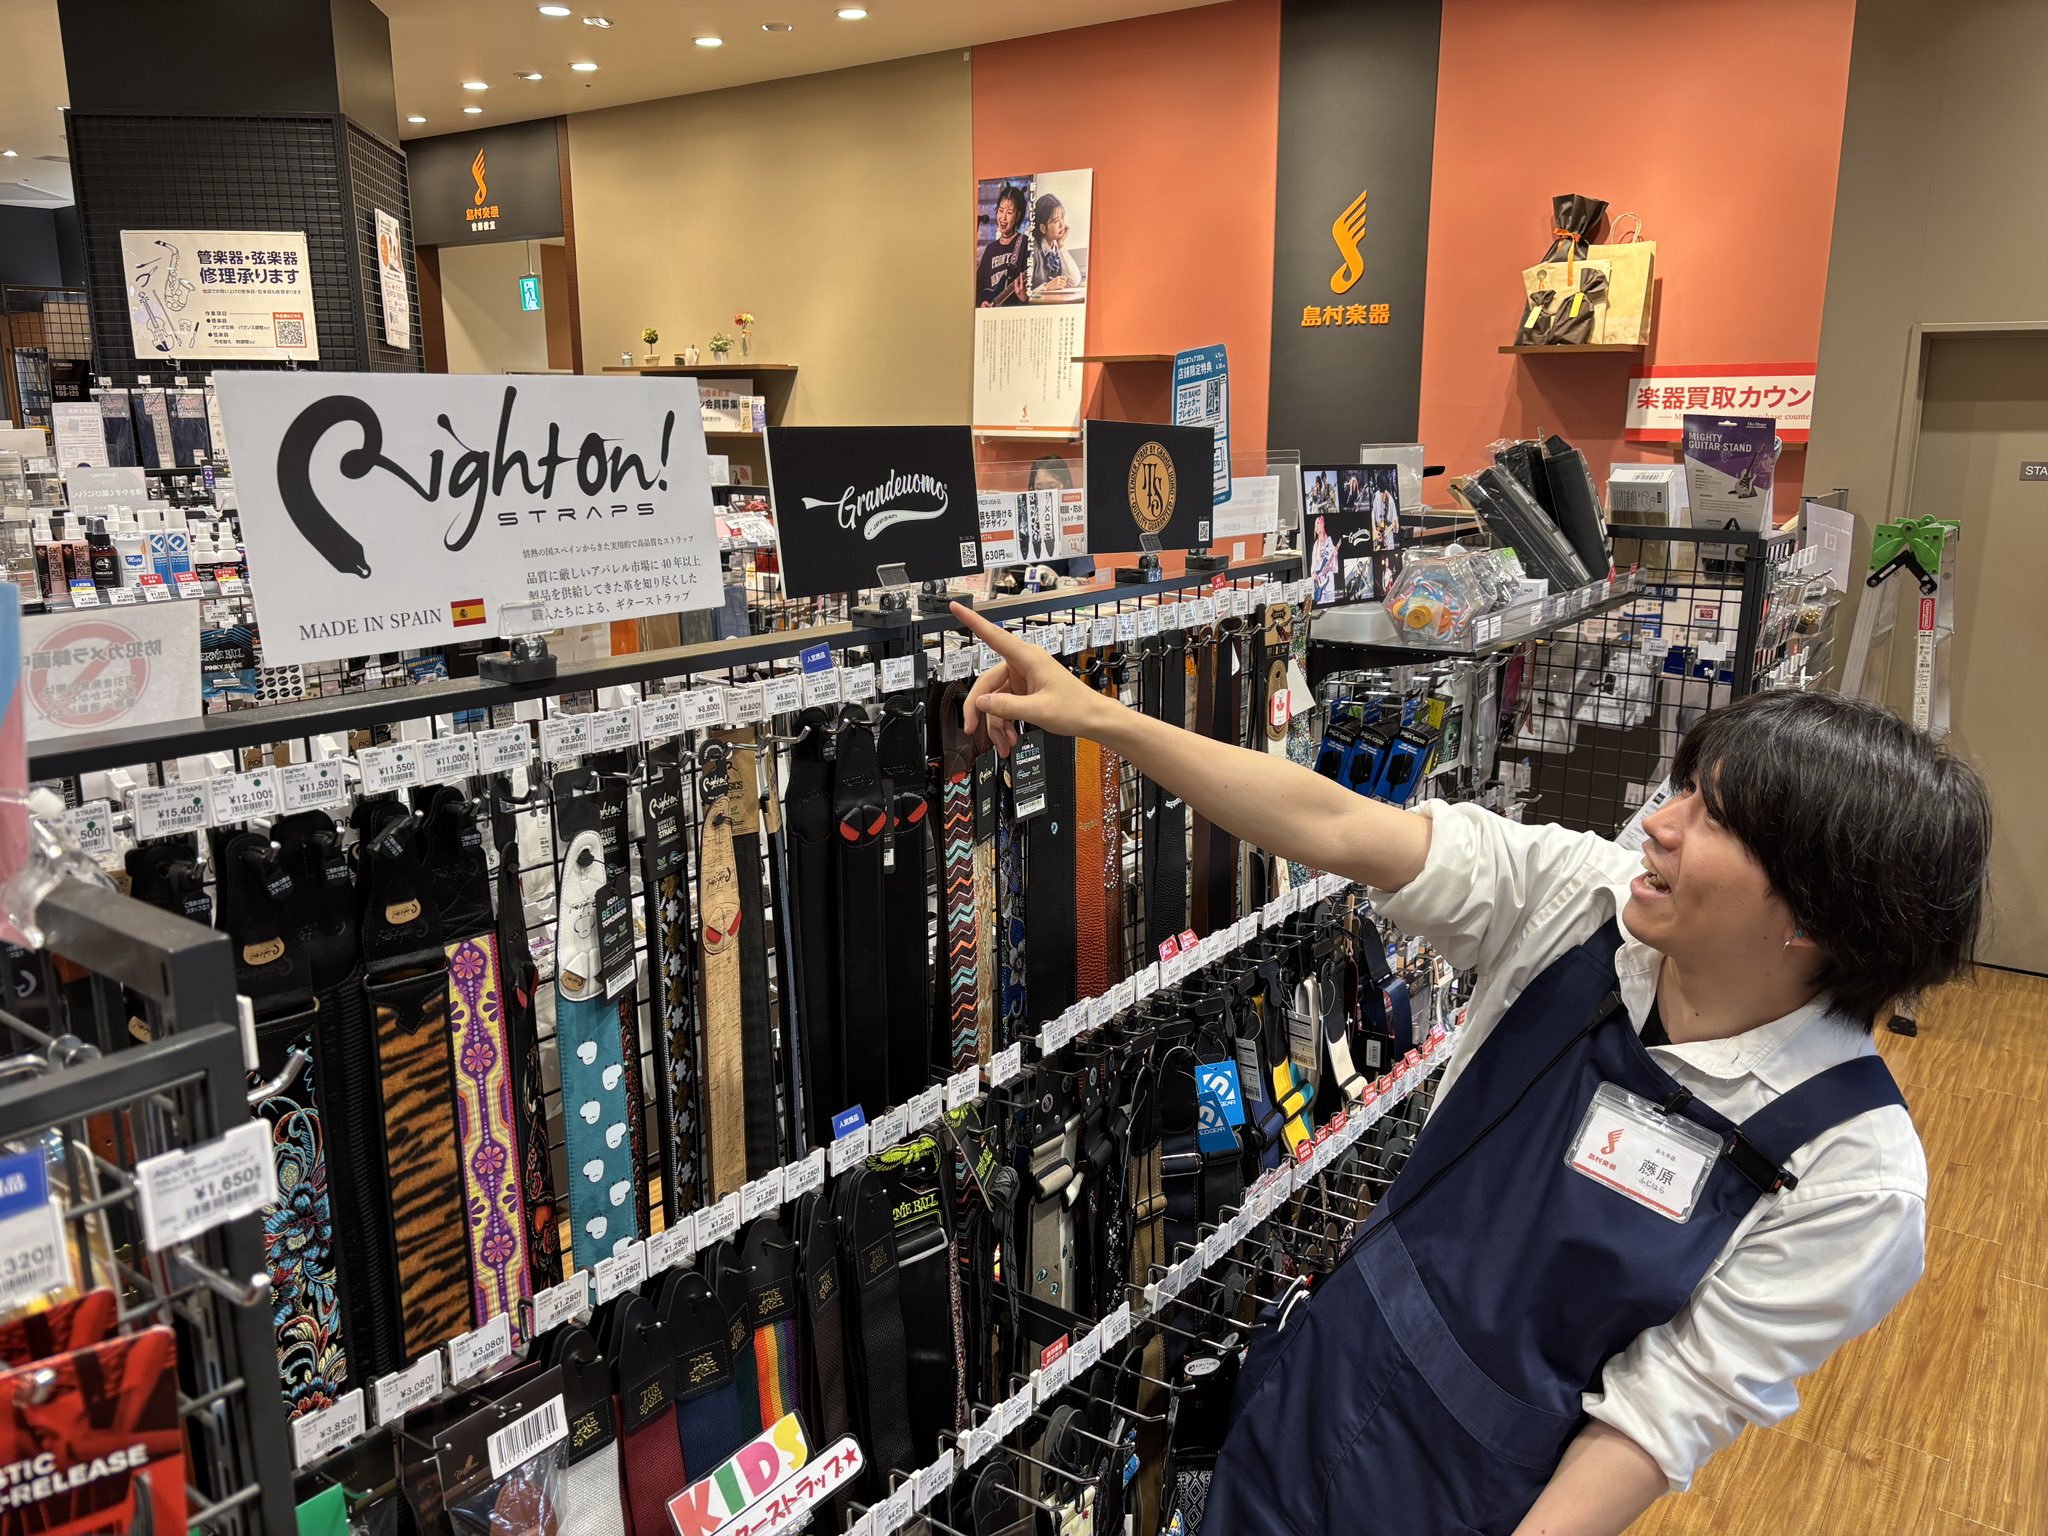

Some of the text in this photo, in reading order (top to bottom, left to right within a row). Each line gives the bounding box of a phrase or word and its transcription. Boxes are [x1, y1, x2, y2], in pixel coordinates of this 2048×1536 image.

[197, 250, 299, 266] 管楽器・弦楽器
[199, 267, 300, 285] 修理承ります
[1300, 303, 1391, 327] 島村楽器
[54, 384, 79, 392] YDS-150
[1637, 385, 1812, 411] 楽器買取カウン
[1688, 432, 1723, 443] MIGHTY
[1688, 441, 1752, 453] GUITAR STAND
[1129, 465, 1138, 494] TENDER
[1137, 446, 1149, 465] STRAP
[1149, 445, 1156, 454] BY
[497, 502, 656, 527] STRAPS
[1131, 501, 1148, 529] QUALITY
[522, 535, 695, 559] 情熱の国スペインからきた実用的で高品質なストラップ
[528, 573, 698, 605] 製品を供給してきた革を知り尽くした
[531, 590, 691, 622] 職人たちによる、ギターストラップ
[298, 607, 443, 642] MADE IN SPAIN
[655, 713, 674, 723] ¥9,900
[606, 725, 627, 735] ¥9,900
[391, 744, 413, 753] STRAPS
[560, 735, 583, 745] ¥9,900
[498, 743, 523, 755] ¥9,900
[1015, 747, 1040, 761] BETTER
[314, 760, 337, 770] STRAPS
[436, 753, 467, 766] ¥11,000
[1016, 754, 1041, 766] TOMORROW
[244, 770, 269, 780] STRAPS
[378, 762, 412, 776] ¥11,550
[177, 785, 203, 795] STRAPS
[299, 780, 336, 793] ¥11,550
[229, 790, 269, 805] ¥12,100
[74, 807, 104, 818] STRAPS
[157, 804, 200, 819] ¥15,400
[601, 898, 626, 921] BETTER
[601, 907, 627, 928] TOMORROW
[1587, 1152, 1617, 1171] 島村楽器
[1638, 1158, 1677, 1186] 藤原
[194, 1168, 254, 1200] ¥1,650
[1638, 1177, 1665, 1194] ふじはら
[756, 1188, 776, 1202] ¥1,280
[913, 1194, 939, 1213] BALL
[710, 1214, 731, 1230] ¥1,280
[663, 1238, 686, 1255] ¥1,280
[614, 1264, 637, 1281] ¥1,280
[553, 1292, 579, 1311] ¥1,280
[456, 1333, 479, 1348] Takamine
[472, 1339, 501, 1358] ¥3,080
[382, 1373, 408, 1388] Takamine
[400, 1377, 431, 1398] ¥3,080
[300, 1412, 327, 1429] Takamine
[319, 1417, 353, 1438] ¥3,850
[670, 1412, 808, 1536] KIDS
